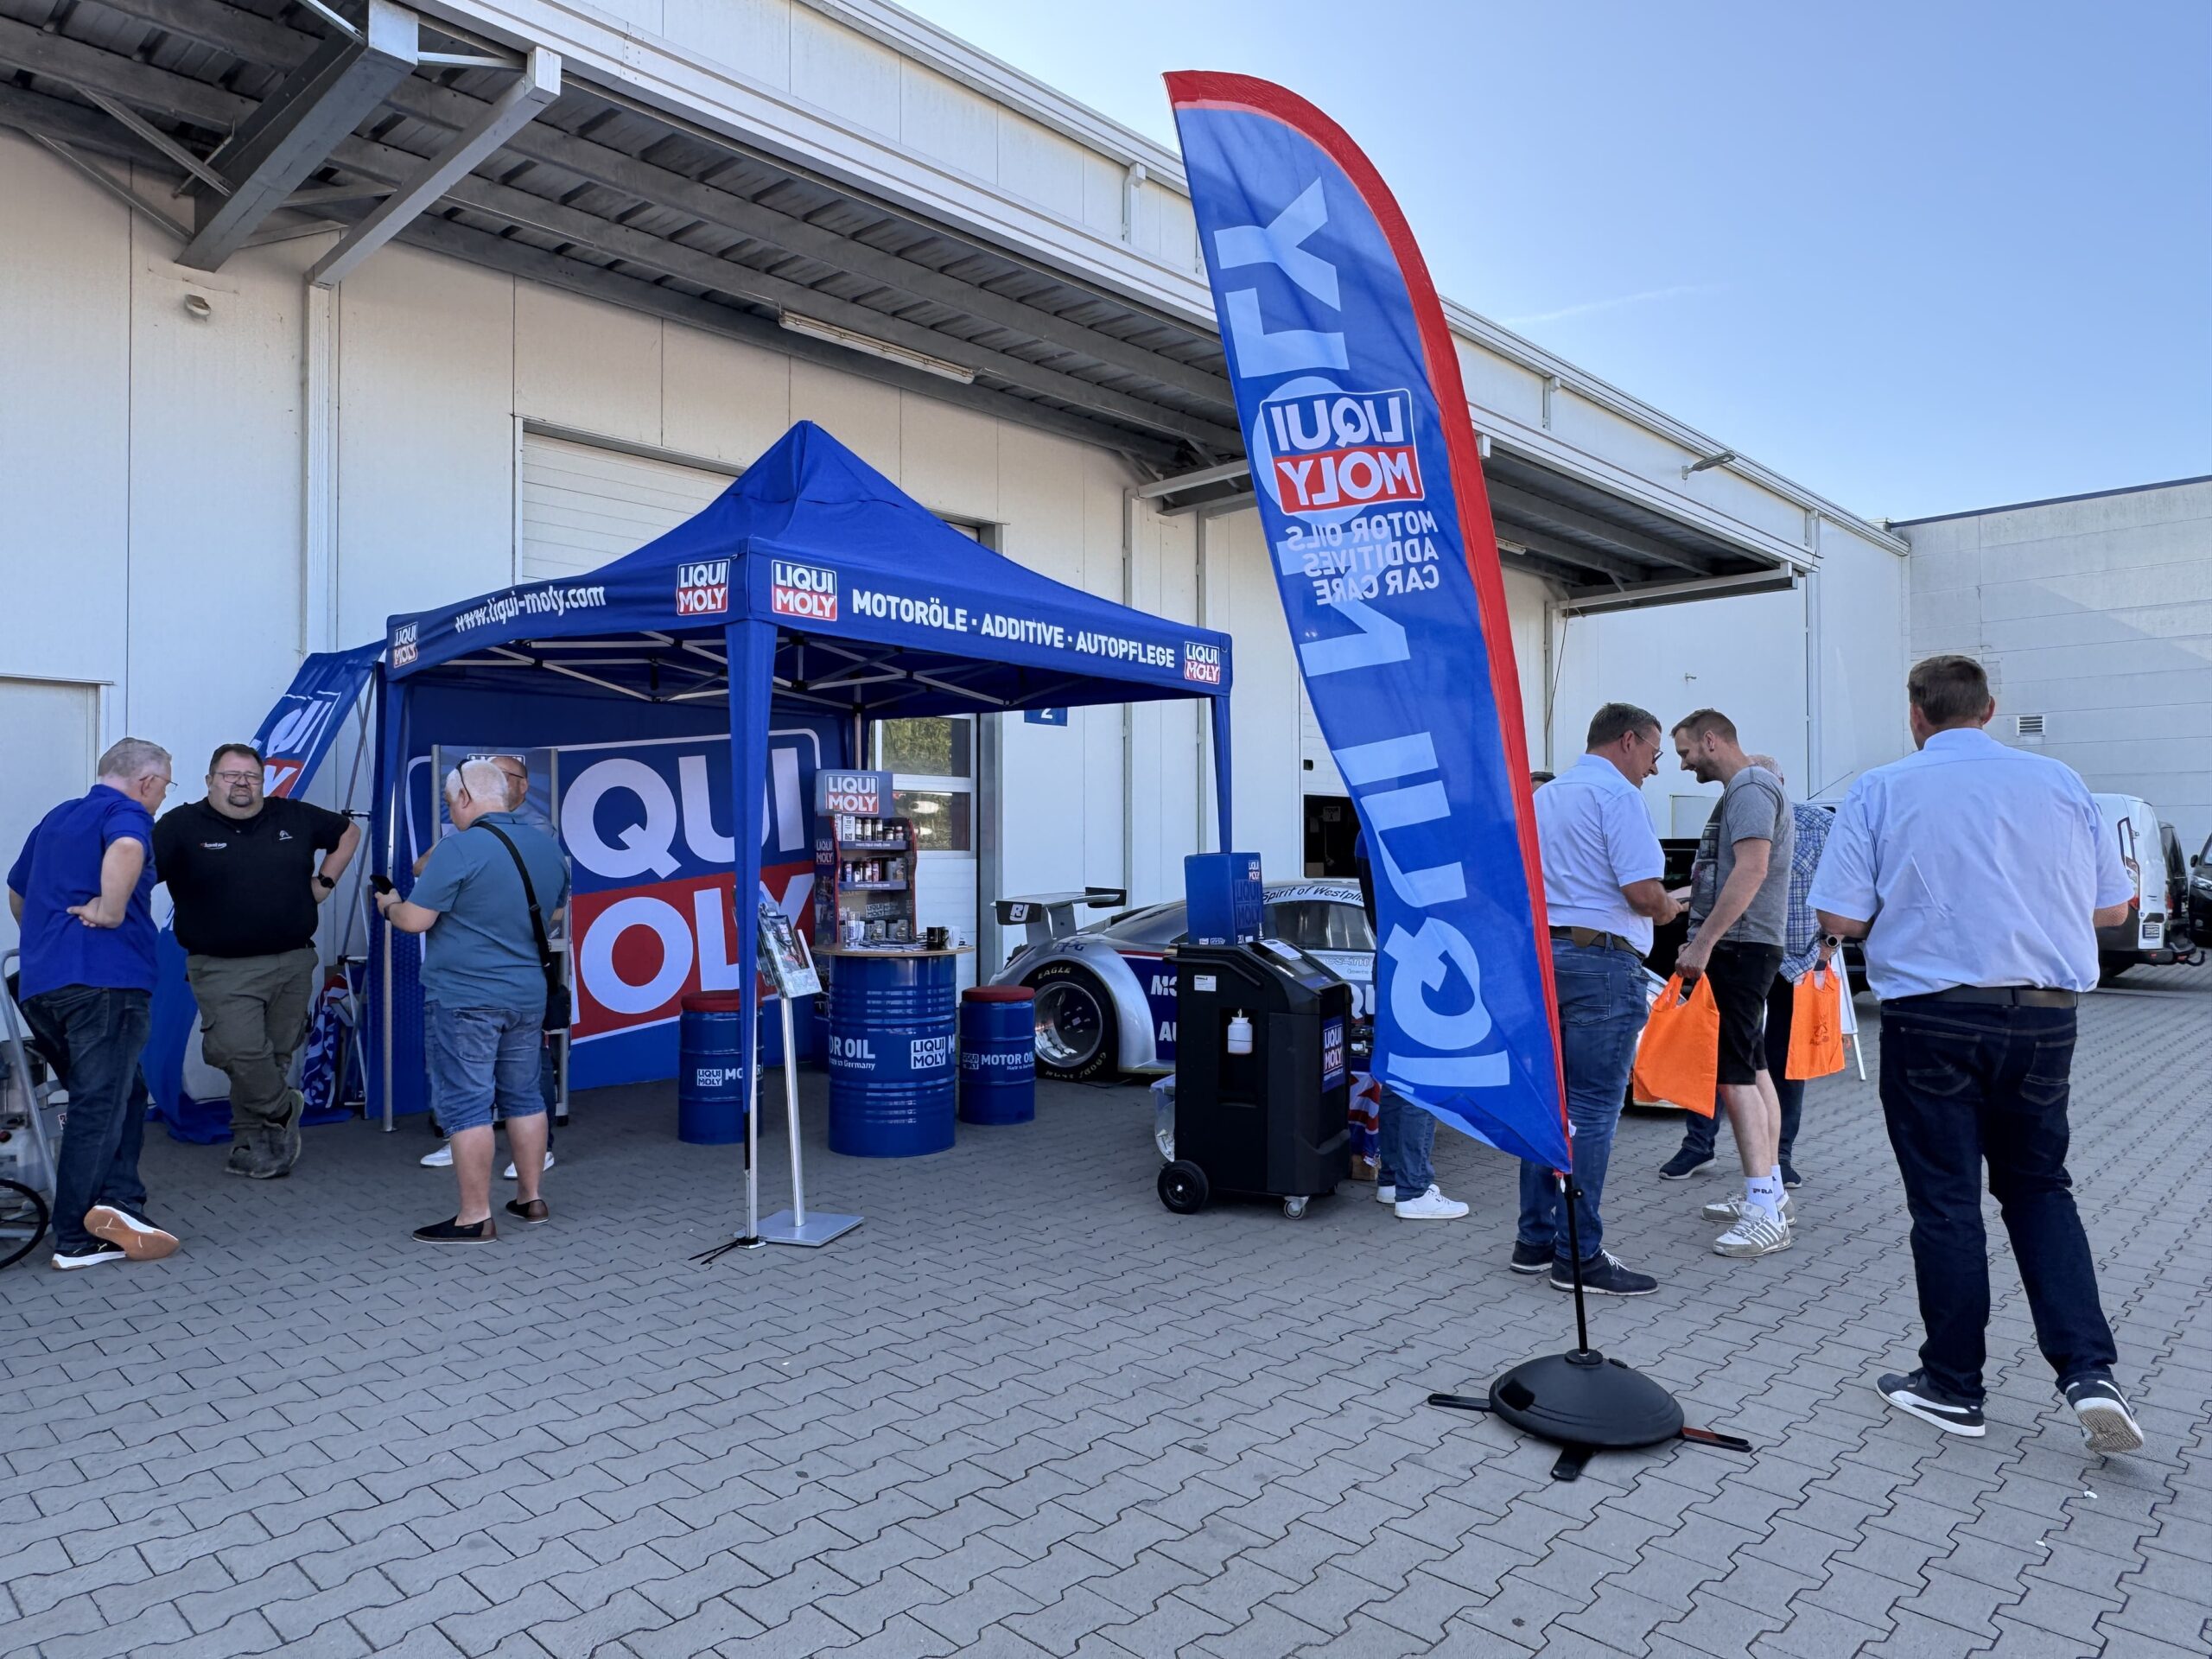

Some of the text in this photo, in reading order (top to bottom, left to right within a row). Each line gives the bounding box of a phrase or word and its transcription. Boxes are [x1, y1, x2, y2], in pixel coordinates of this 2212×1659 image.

[680, 563, 727, 588] LIQUI
[776, 563, 834, 594] LIQUI
[454, 585, 606, 632] www.liqui-moly.com
[679, 587, 727, 613] MOLY
[776, 589, 836, 618] MOLY
[395, 624, 417, 646] LIQUI
[852, 588, 1175, 668] MOTORÖLE ADDITIVE AUTOPFLEGE
[394, 643, 416, 665] MOLY
[1186, 644, 1218, 664] LIQUI
[1185, 662, 1219, 683] MOLY
[828, 777, 877, 794] LIQUI
[828, 794, 878, 812] MOLY
[816, 839, 833, 851] LIQUI
[816, 851, 834, 863] MOLY
[1263, 886, 1297, 903] Spirit
[1297, 887, 1313, 896] of
[570, 873, 816, 1025] OLY
[844, 1038, 875, 1059] OIL
[912, 1038, 944, 1053] LIQUI
[1324, 1027, 1343, 1049] LIQUI
[843, 1059, 876, 1071] Germany
[912, 1052, 945, 1068] MOLY
[981, 1053, 1021, 1065] MOTOR
[1324, 1046, 1343, 1071] MOLY
